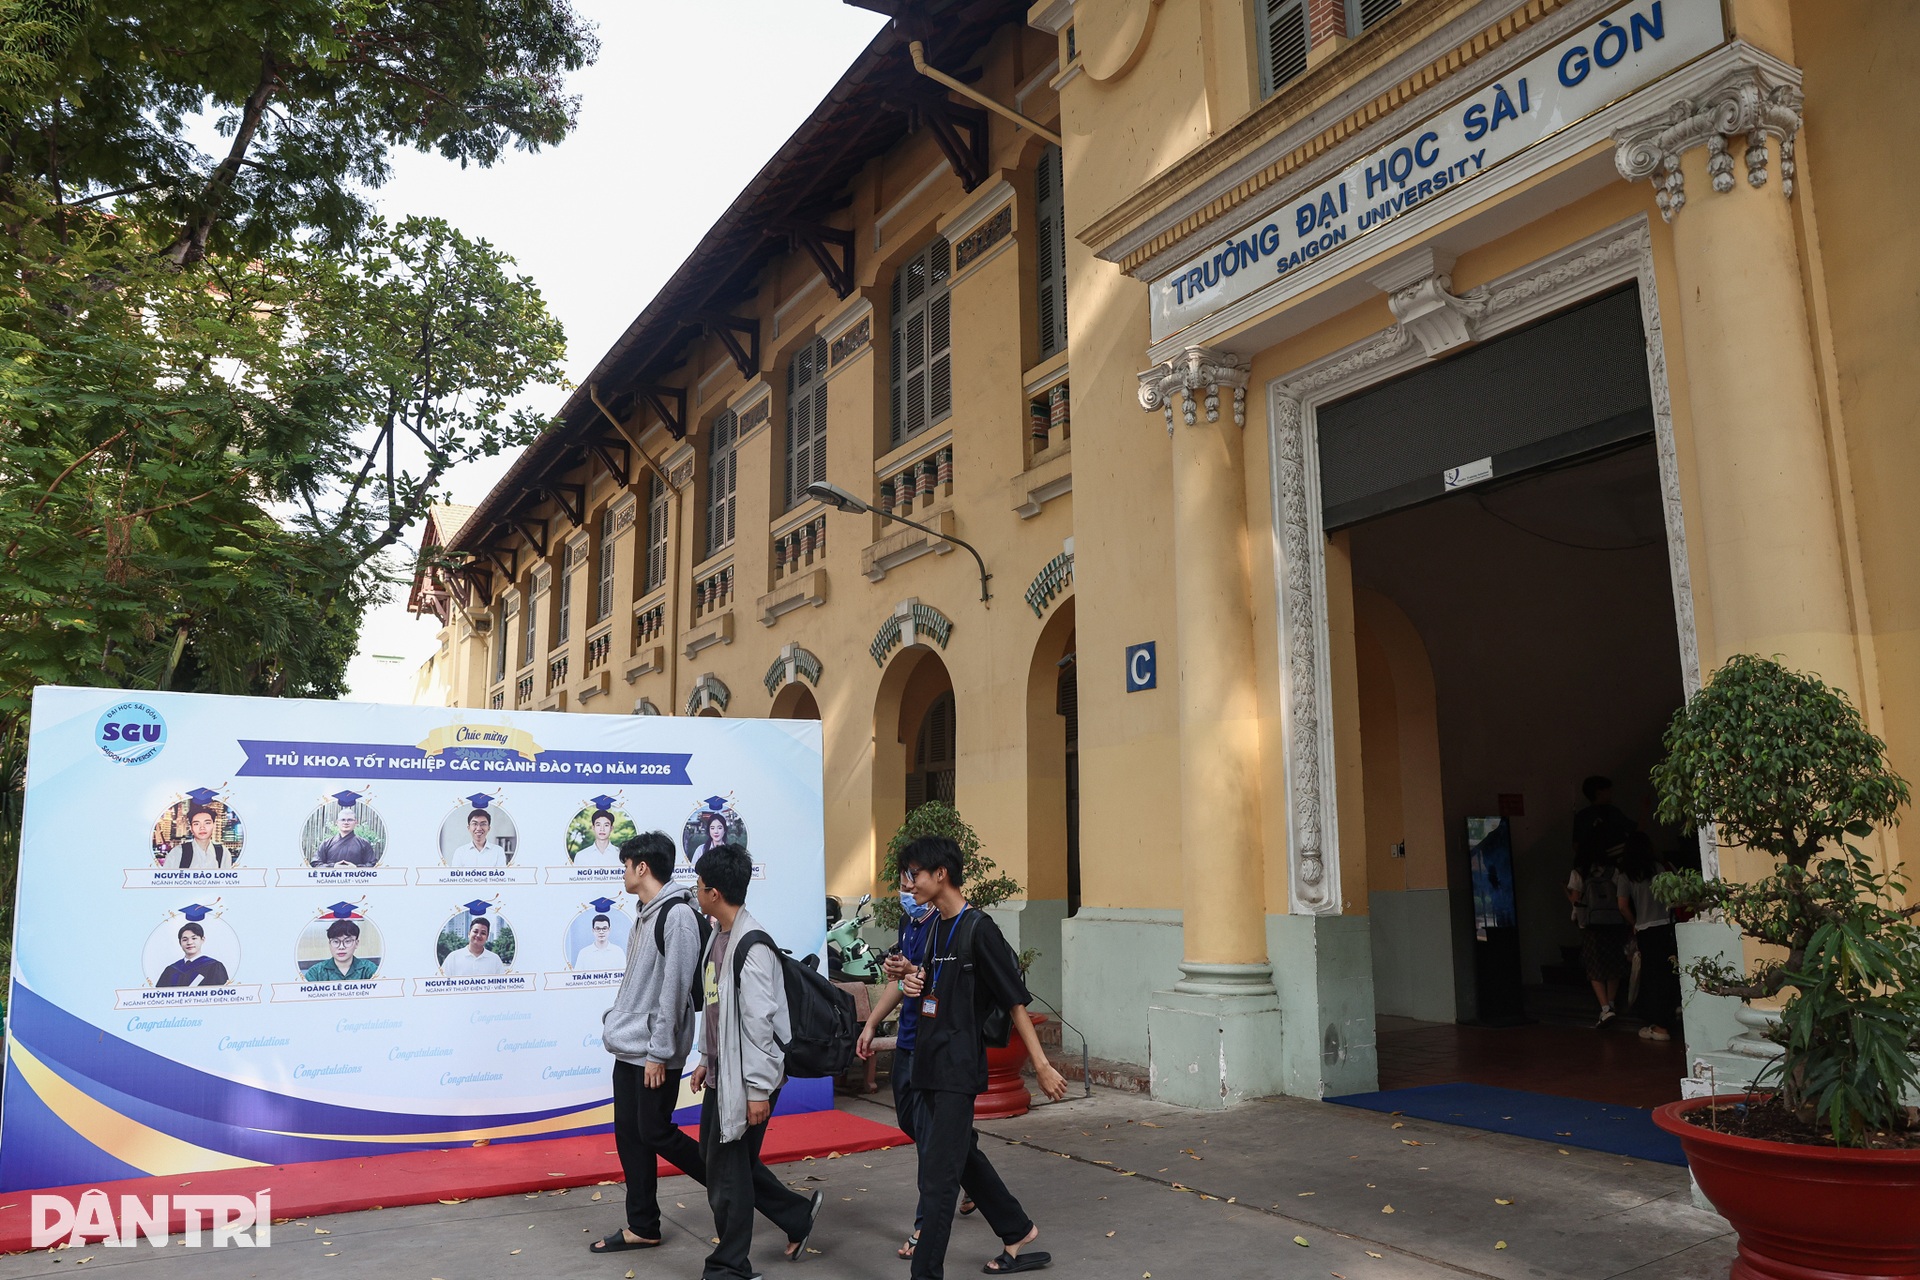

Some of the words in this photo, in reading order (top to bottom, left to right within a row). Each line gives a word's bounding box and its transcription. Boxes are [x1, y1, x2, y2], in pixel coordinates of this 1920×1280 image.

[1172, 224, 1279, 304] TRƯỜNG
[1296, 183, 1347, 238] ĐẠI
[1365, 131, 1440, 198] HỌC
[1463, 78, 1530, 142] SÀI
[1558, 0, 1664, 88] GÒN
[1276, 225, 1346, 274] SAIGON
[1357, 148, 1486, 230] UNIVERSITY
[1131, 649, 1150, 685] C
[102, 722, 161, 742] SGU
[456, 726, 481, 742] Chúc
[483, 730, 508, 745] mừng
[102, 745, 122, 762] SAIGON
[122, 747, 157, 764] UNIVERSITY
[265, 751, 298, 766] THỦ
[304, 755, 350, 768] KHOA
[354, 753, 385, 768] TỐT
[389, 756, 446, 772] NGHIỆP
[450, 757, 480, 772] CÁC
[484, 758, 536, 772] NGÀNH
[539, 758, 570, 774] ĐÀO
[576, 763, 603, 776] TẠO
[607, 760, 637, 774] NĂM
[640, 764, 671, 774] 2026
[154, 870, 190, 879] NGUYỄN
[593, 972, 612, 980] NHẬT
[300, 984, 330, 992] HOÀNG
[127, 1016, 202, 1032] Congratulations
[470, 1010, 532, 1024] Congratulations
[336, 1018, 402, 1033] Congratulations
[218, 1036, 290, 1051] Congratulations
[496, 1038, 558, 1052] Congratulations
[388, 1046, 454, 1061] Congratulations
[293, 1064, 362, 1079] Congratulations
[440, 1071, 503, 1086] Congratulations
[542, 1065, 601, 1080] Congratulations
